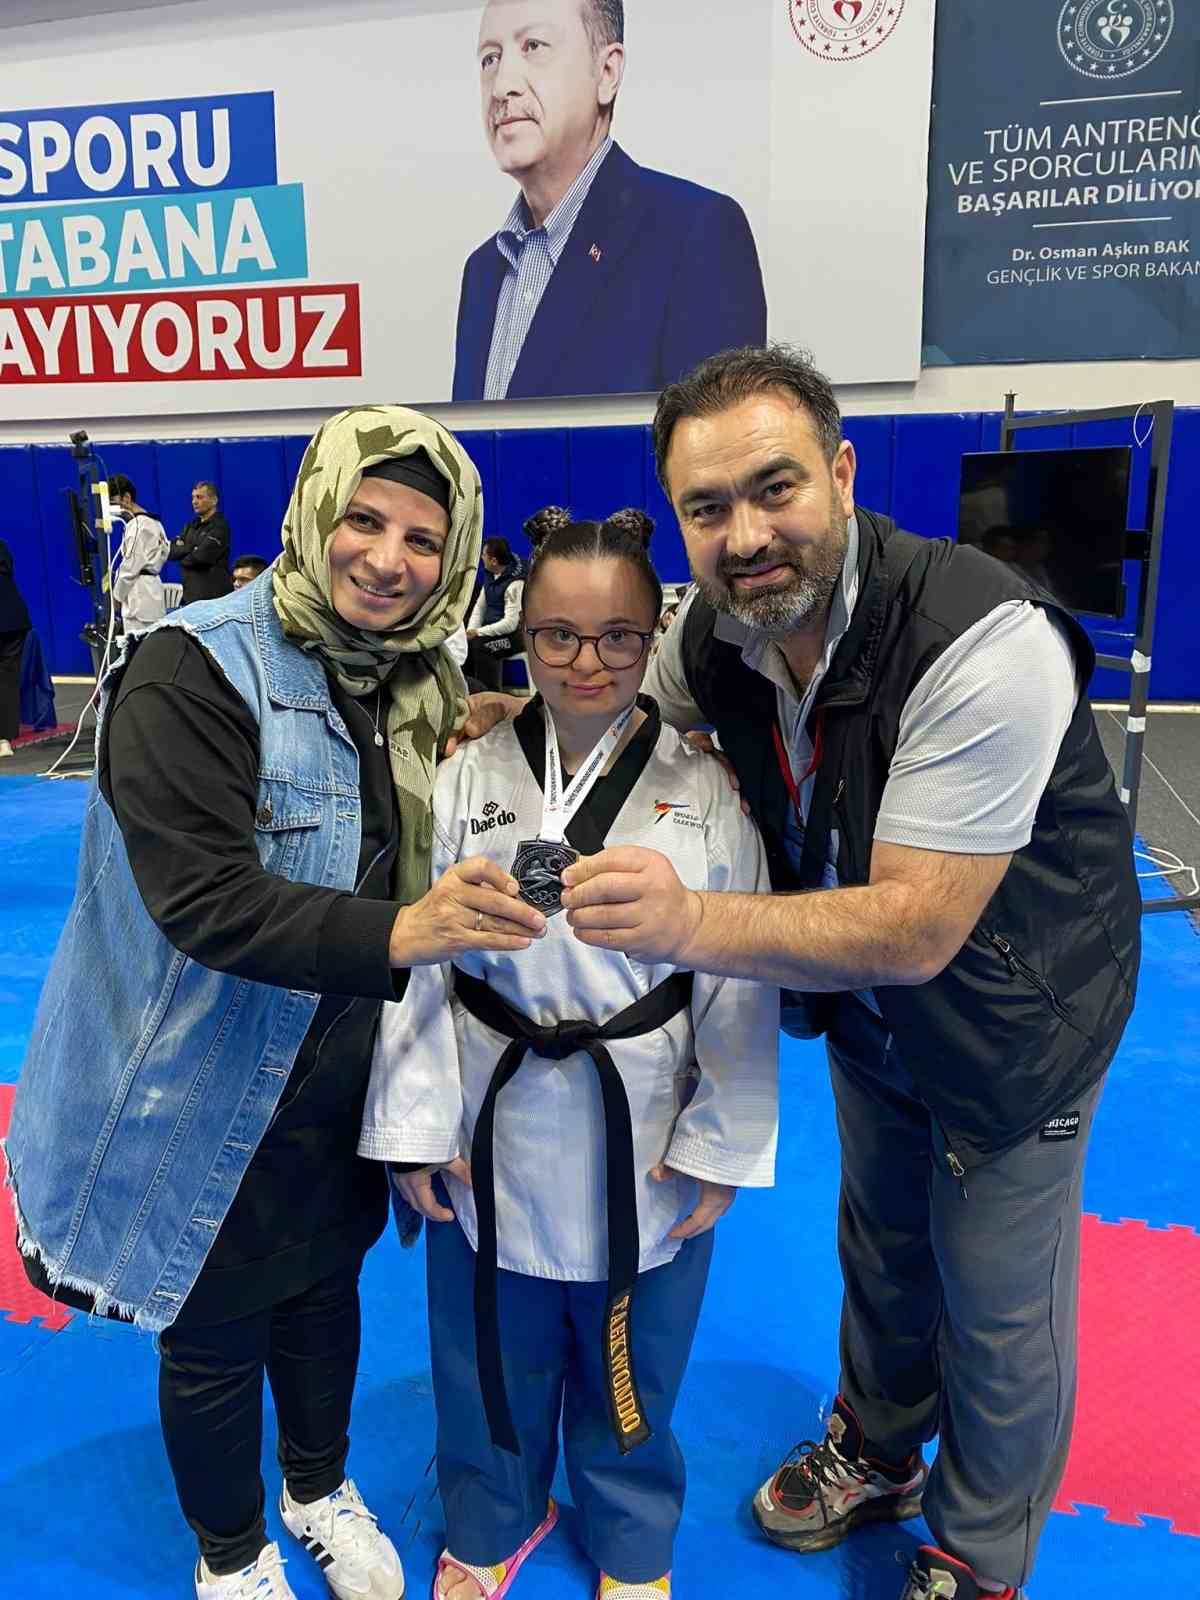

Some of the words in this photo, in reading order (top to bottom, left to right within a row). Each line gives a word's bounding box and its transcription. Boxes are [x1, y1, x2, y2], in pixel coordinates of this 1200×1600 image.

[0, 107, 231, 196] SPORU
[984, 124, 1051, 154] TÜM
[948, 160, 984, 186] VE
[957, 186, 1099, 217] BAŞARILAR
[1012, 248, 1035, 262] Dr.
[1039, 246, 1097, 260] Osman
[1102, 242, 1150, 259] Aşkın
[1154, 239, 1190, 254] BAK
[987, 266, 1061, 286] GENÇLİK
[1065, 265, 1087, 281] VE
[1092, 263, 1140, 279] SPOR
[471, 810, 516, 835] Daedo
